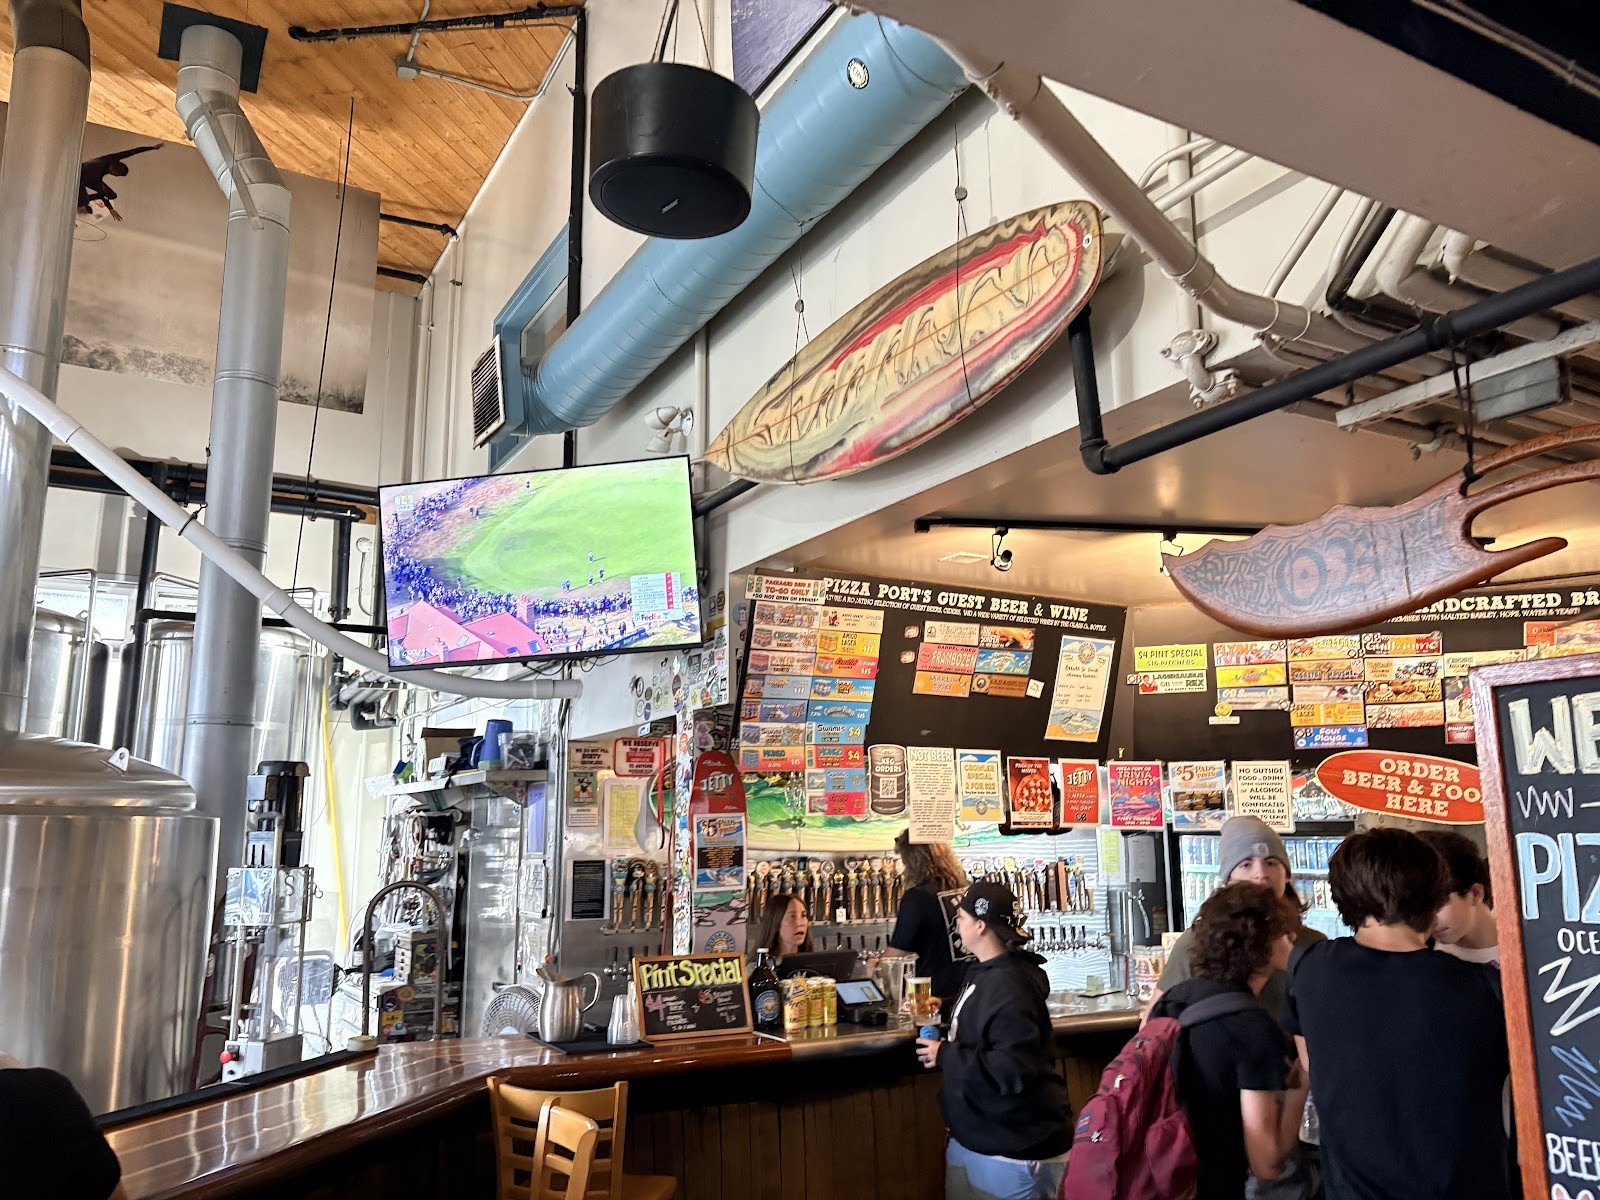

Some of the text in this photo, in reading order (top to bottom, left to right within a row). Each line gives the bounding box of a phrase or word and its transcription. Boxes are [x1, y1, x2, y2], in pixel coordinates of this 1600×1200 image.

[765, 586, 810, 596] TO-GO ONLY
[823, 577, 1090, 622] PIZZA PORT'S GUEST BEER & WINE
[1421, 613, 1440, 621] WITH
[1521, 609, 1548, 617] WATER
[931, 650, 978, 668] FRAMBOZEN
[1150, 649, 1169, 659] PINT
[1170, 649, 1203, 658] SPECIAL
[848, 726, 862, 737] $4
[1508, 690, 1600, 776] WE
[847, 749, 860, 761] $4
[909, 748, 952, 763] NOT BEER
[874, 765, 902, 773] ORDERS
[1116, 771, 1153, 779] TRIVIA
[1176, 765, 1195, 781] $5
[1379, 757, 1461, 783] ORDER
[700, 773, 735, 792] JETTY
[967, 773, 994, 781] SPECIAL
[1067, 769, 1095, 786] JETTY
[1117, 778, 1155, 787] NIGHTS
[971, 782, 984, 790] FOR
[1341, 769, 1484, 804] BEER & FOO
[1385, 793, 1449, 818] HERE
[639, 957, 743, 992] Pint Special
